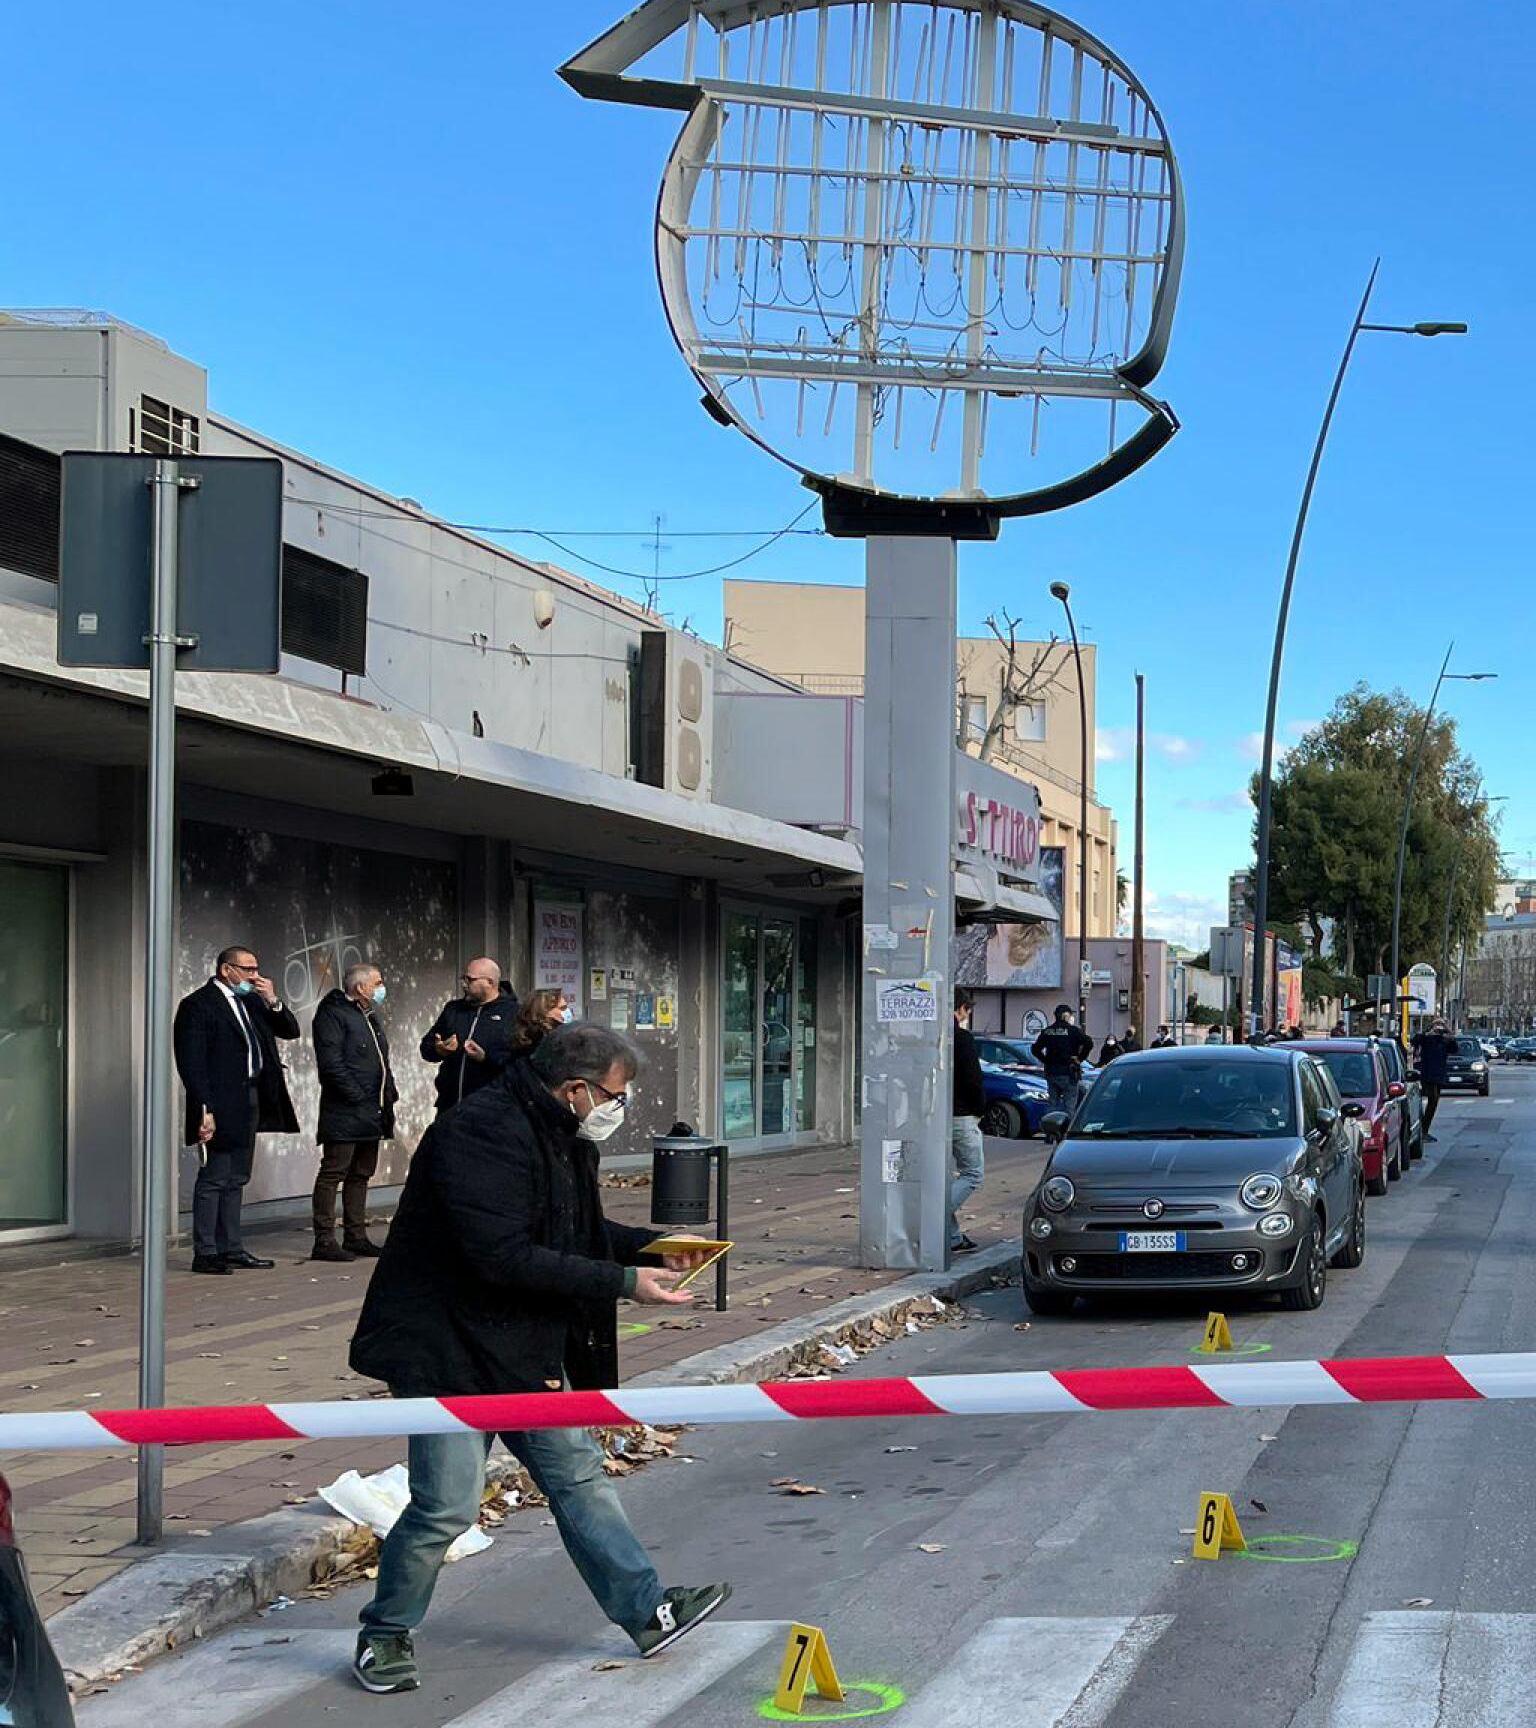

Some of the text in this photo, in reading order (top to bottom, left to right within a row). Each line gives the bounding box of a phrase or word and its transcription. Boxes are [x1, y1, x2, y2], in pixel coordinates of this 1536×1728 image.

[880, 998, 935, 1009] TERRAZZI
[1202, 1499, 1217, 1546] 6
[787, 1634, 809, 1692] 7
